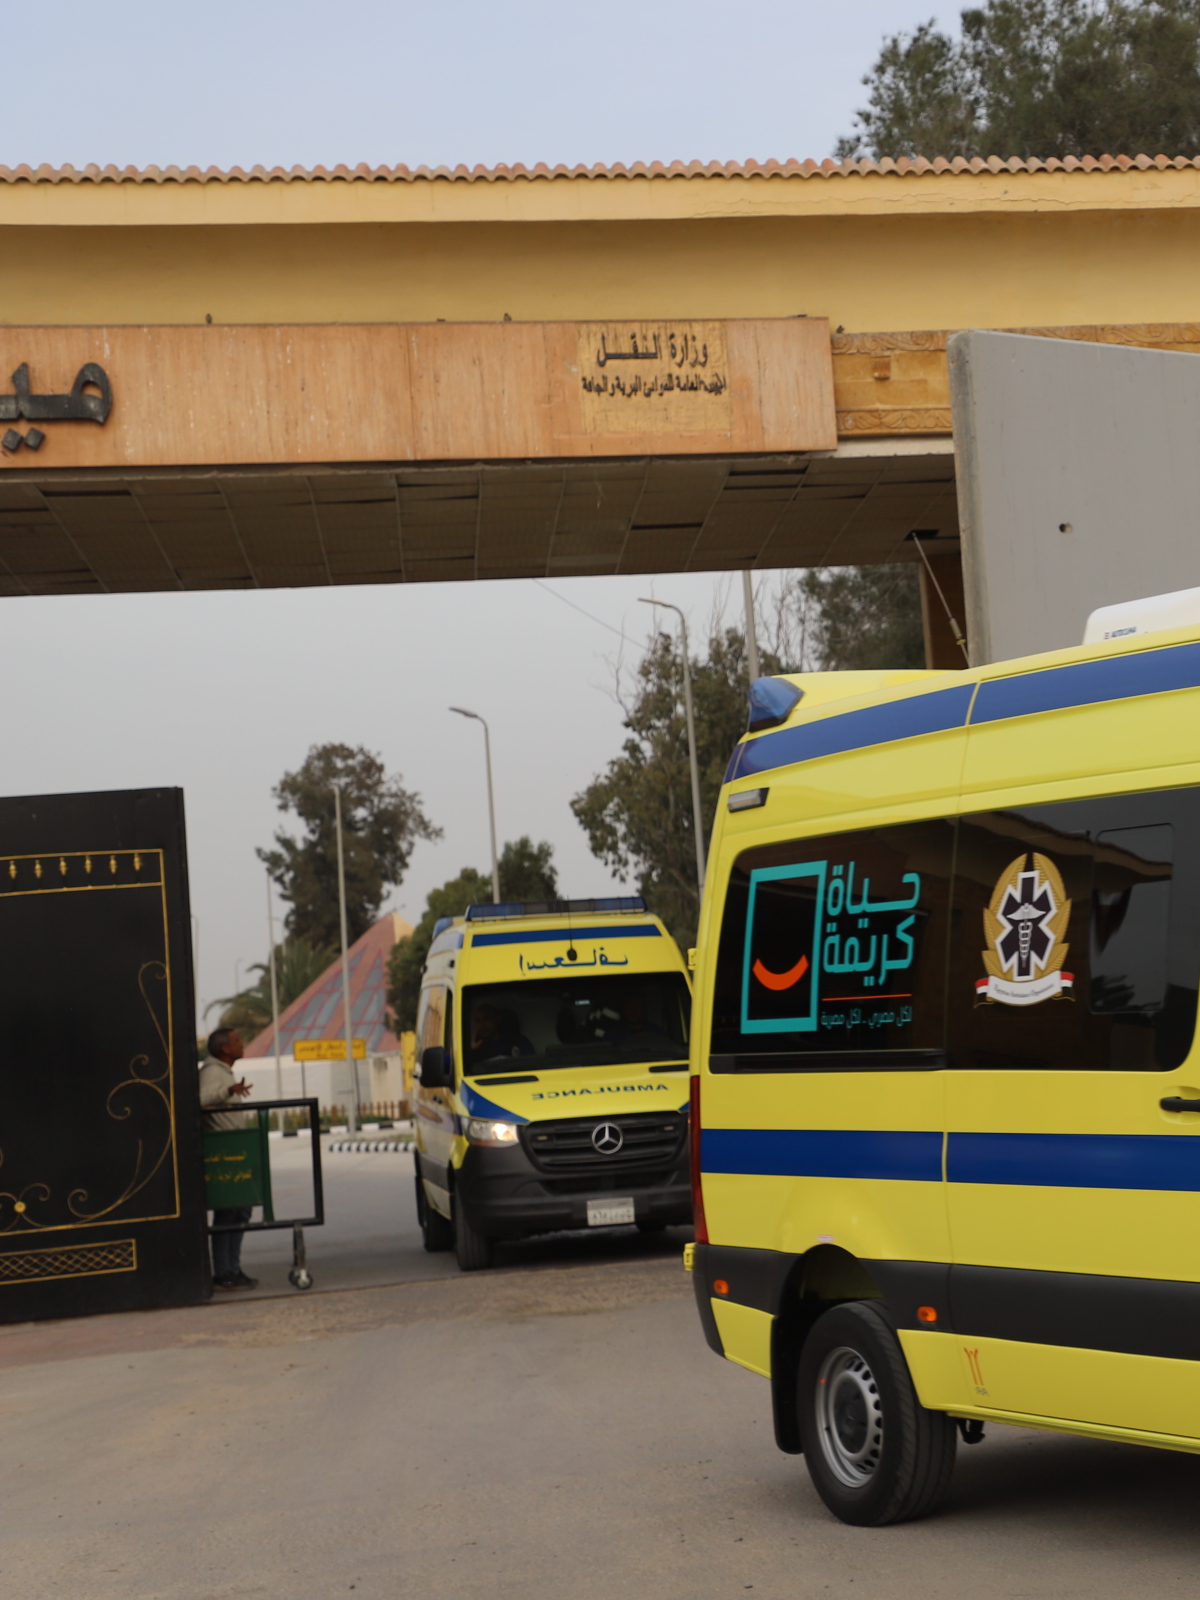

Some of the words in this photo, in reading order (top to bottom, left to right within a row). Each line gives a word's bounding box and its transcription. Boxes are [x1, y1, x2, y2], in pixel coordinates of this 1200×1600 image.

[596, 332, 662, 368] النقل
[669, 332, 708, 368] وزارة
[827, 861, 920, 928] حياة
[823, 914, 915, 986] كريمة
[821, 1011, 845, 1030] مصرية
[846, 1009, 861, 1029] لكل
[868, 1012, 895, 1029] مصري
[896, 1006, 912, 1027] لكل
